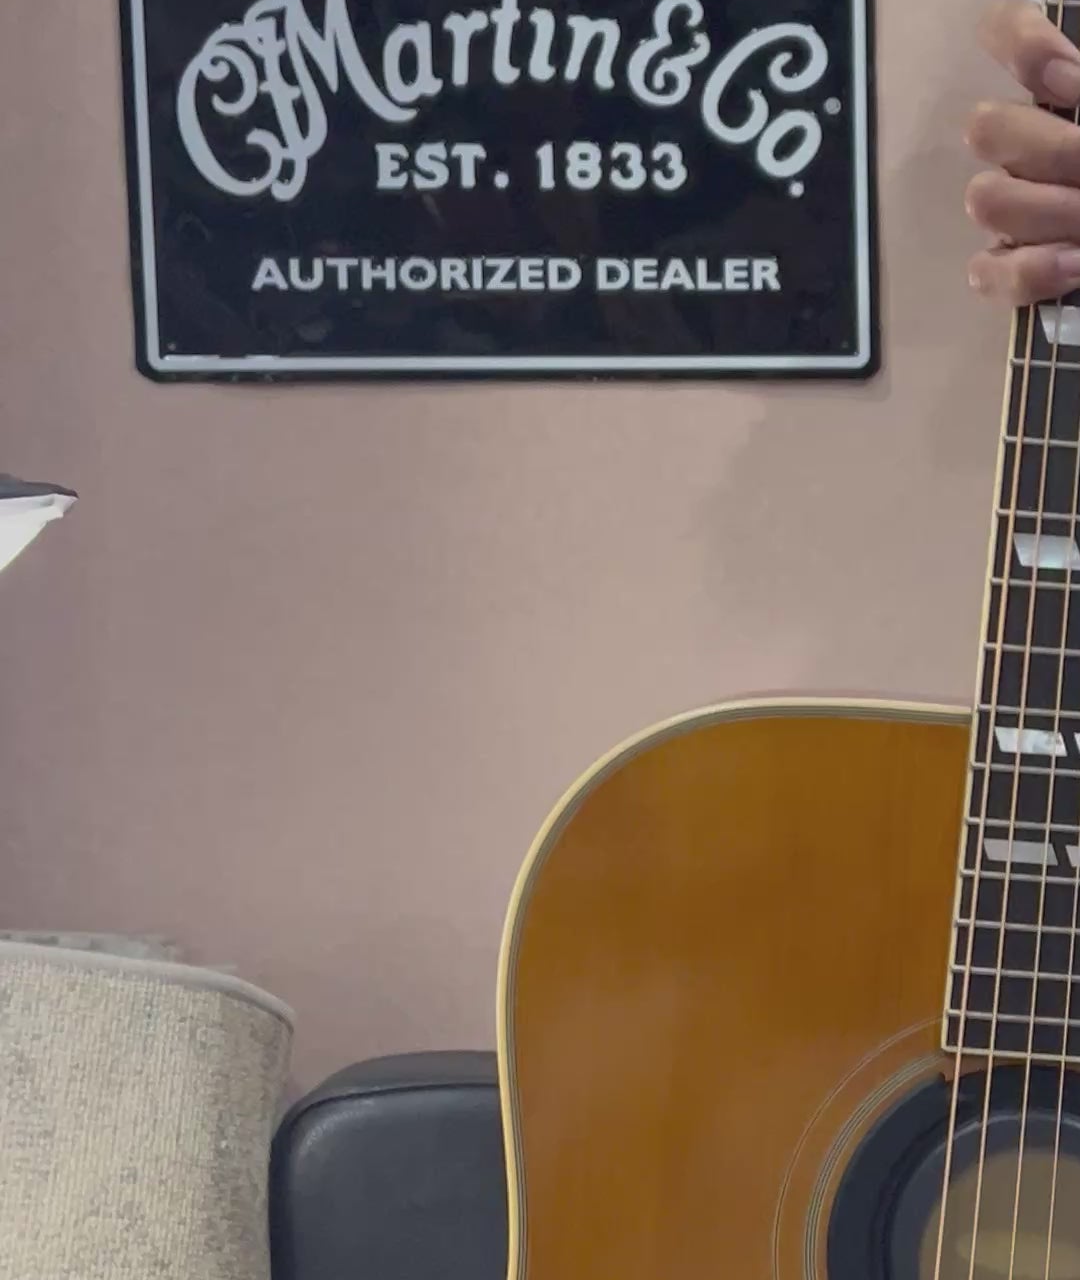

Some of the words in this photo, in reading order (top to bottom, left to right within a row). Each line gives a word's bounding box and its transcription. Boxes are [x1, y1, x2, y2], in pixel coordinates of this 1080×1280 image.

[375, 141, 510, 190] EST.
[536, 141, 688, 191] 1833
[251, 257, 583, 291] AUTHORIZED
[596, 257, 781, 292] DEALER
